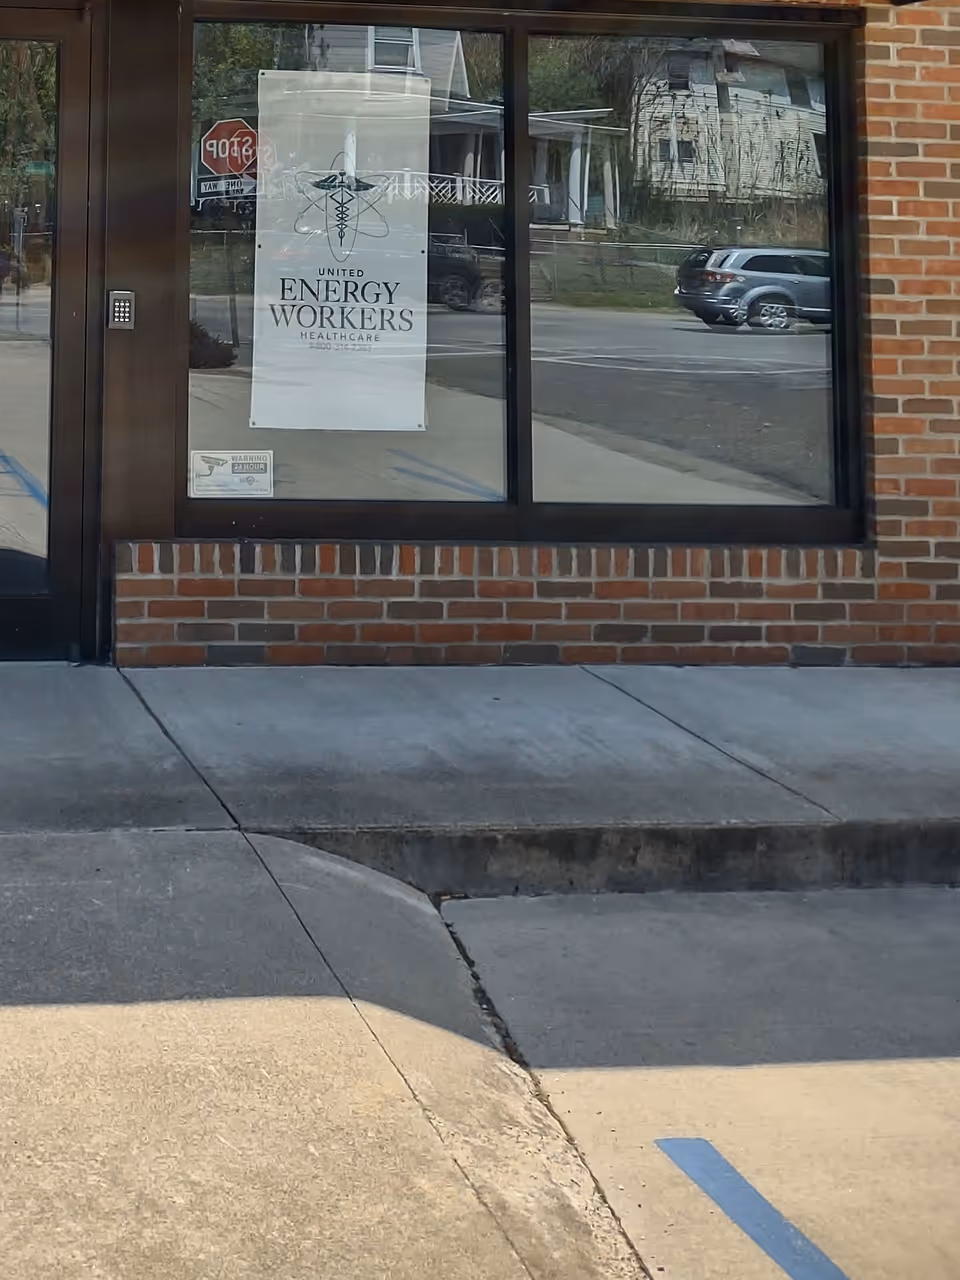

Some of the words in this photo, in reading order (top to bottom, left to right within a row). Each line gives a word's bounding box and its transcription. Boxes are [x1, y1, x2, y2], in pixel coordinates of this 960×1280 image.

[318, 267, 364, 278] UNITED
[279, 277, 401, 305] ENERGY
[269, 304, 414, 332] WORKERS
[300, 331, 381, 342] HEALTHCARE
